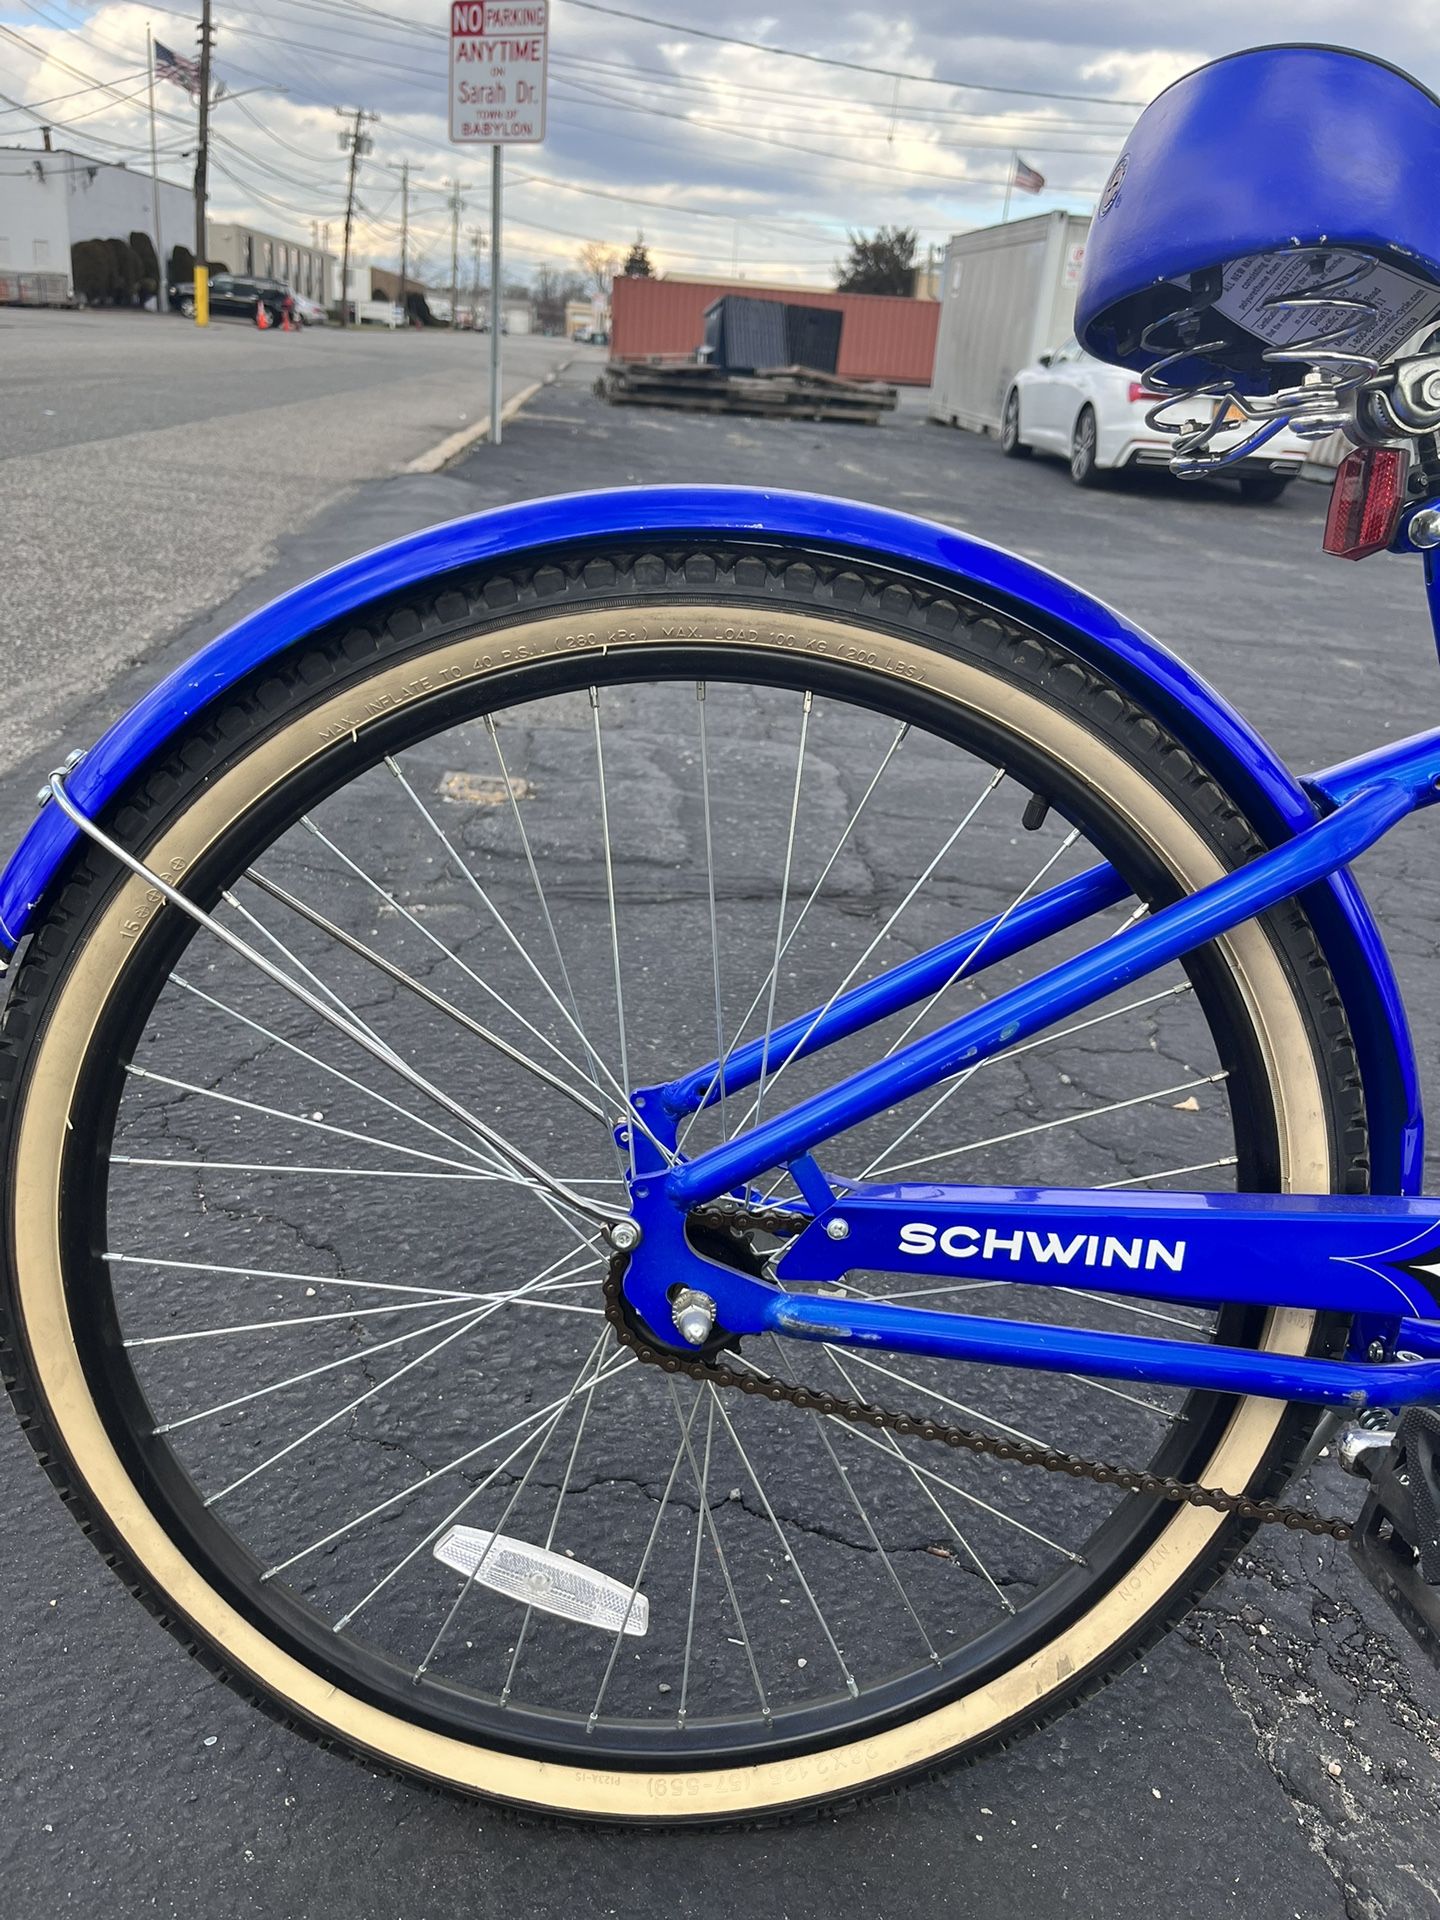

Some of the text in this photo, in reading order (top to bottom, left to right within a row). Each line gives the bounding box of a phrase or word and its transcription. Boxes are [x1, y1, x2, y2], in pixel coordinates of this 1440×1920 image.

[453, 4, 545, 33] NO PARKING
[456, 39, 541, 63] ANYTIME
[457, 80, 539, 105] Sarah Dr.
[461, 122, 533, 137] BABYLON
[1394, 315, 1418, 336] China
[317, 714, 360, 742] MAX.
[363, 676, 432, 714] INFLATE
[439, 666, 462, 680] TO
[472, 655, 493, 672] 40
[662, 625, 702, 639] MAX.
[715, 626, 758, 643] LOAD
[769, 631, 796, 648] 100
[806, 637, 828, 653] KG
[898, 1222, 1186, 1272] SCHWINN
[1117, 1543, 1170, 1602] NYLON
